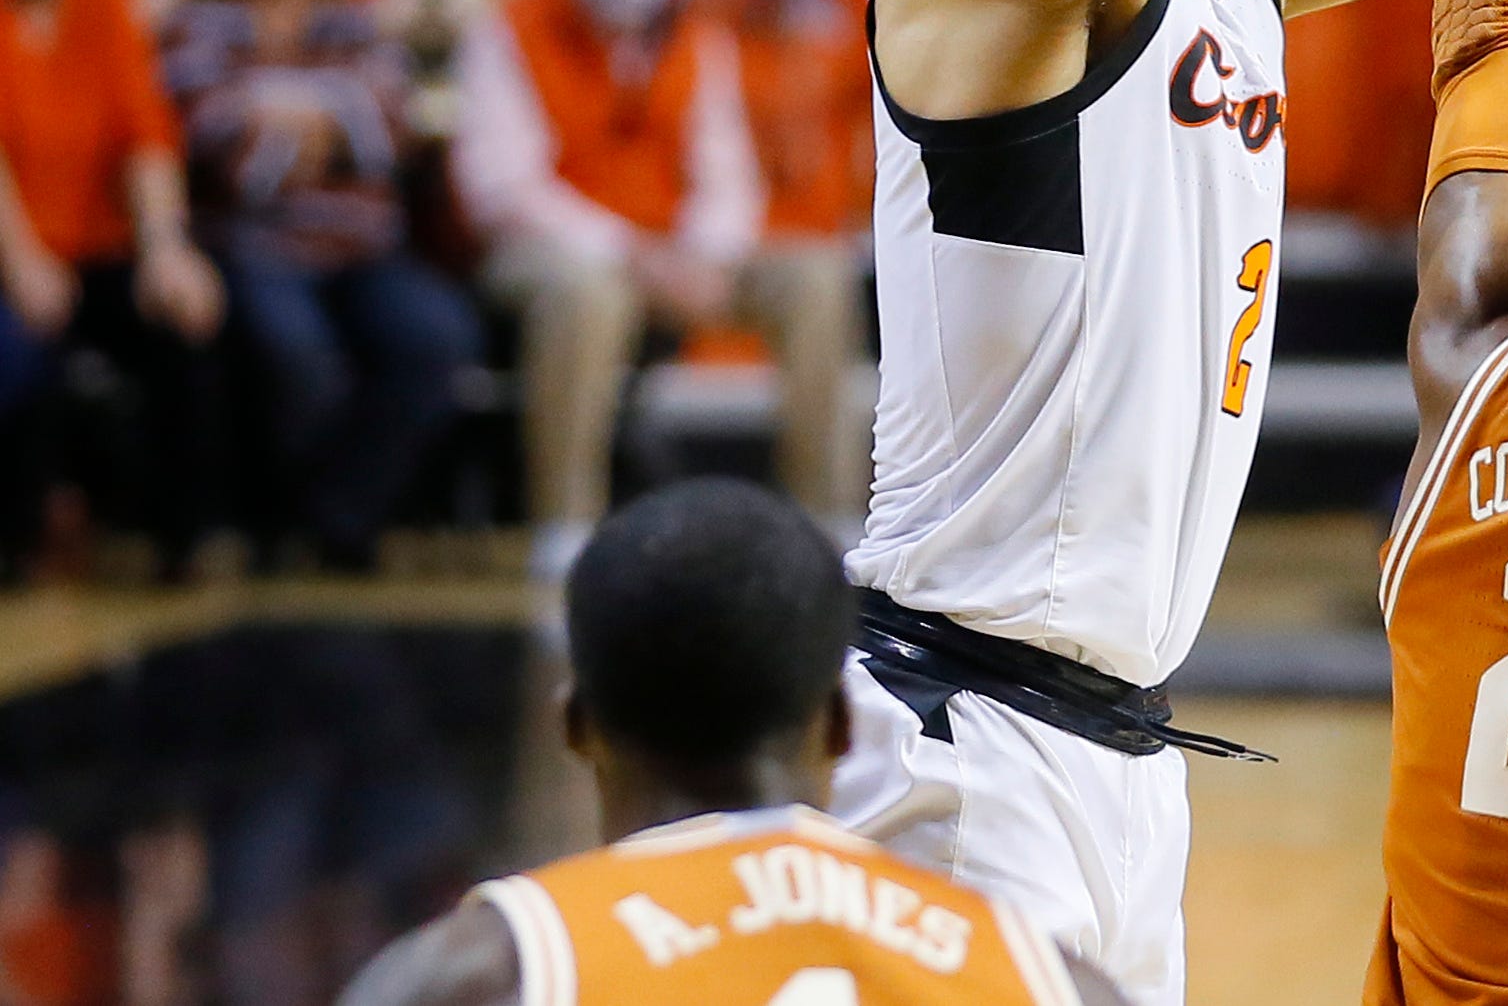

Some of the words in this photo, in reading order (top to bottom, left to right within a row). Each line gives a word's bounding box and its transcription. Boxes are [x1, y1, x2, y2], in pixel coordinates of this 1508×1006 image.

[1220, 239, 1273, 418] 2
[612, 891, 721, 968] A.
[728, 843, 973, 974] JONES
